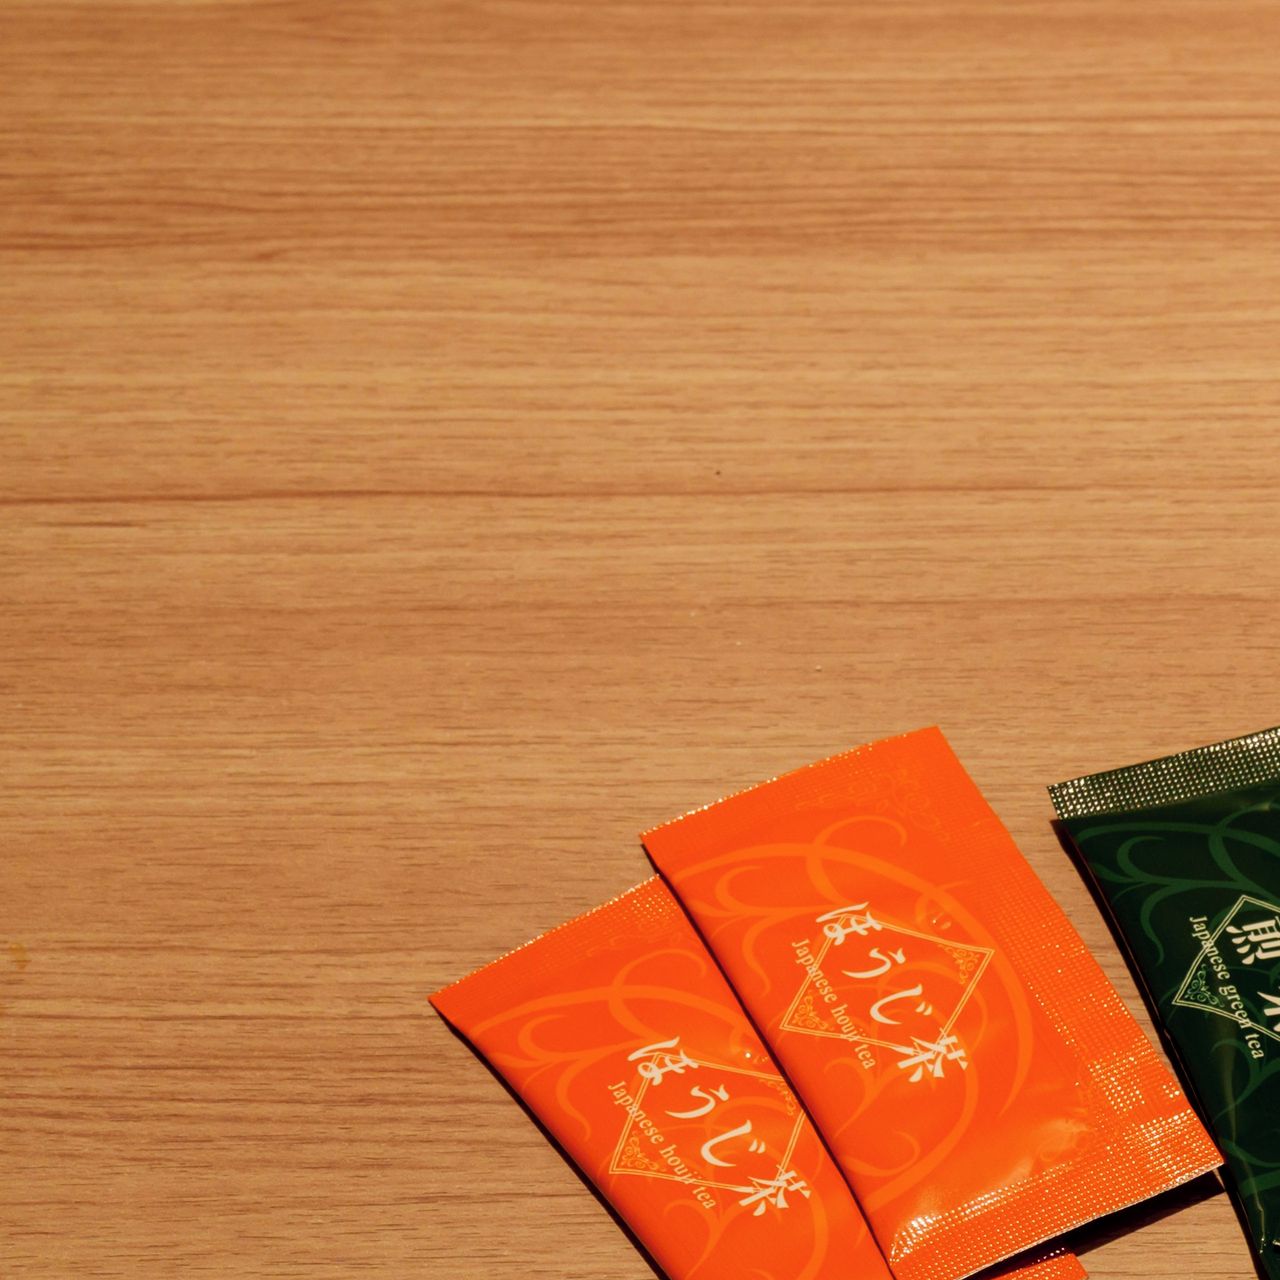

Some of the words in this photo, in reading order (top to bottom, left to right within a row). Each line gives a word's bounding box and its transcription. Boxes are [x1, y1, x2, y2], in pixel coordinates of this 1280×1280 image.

[791, 938, 838, 1004] Japanese
[831, 1003, 867, 1042] houji
[854, 1043, 877, 1070] tea
[815, 901, 968, 1083] ほうじ茶
[1189, 915, 1230, 980] Japanese
[1218, 984, 1251, 1029] green
[1245, 1033, 1265, 1060] tea
[607, 1080, 665, 1145] Japanese
[659, 1144, 701, 1185] houji
[692, 1186, 717, 1209] tea
[627, 1036, 812, 1217] ほうじ茶
